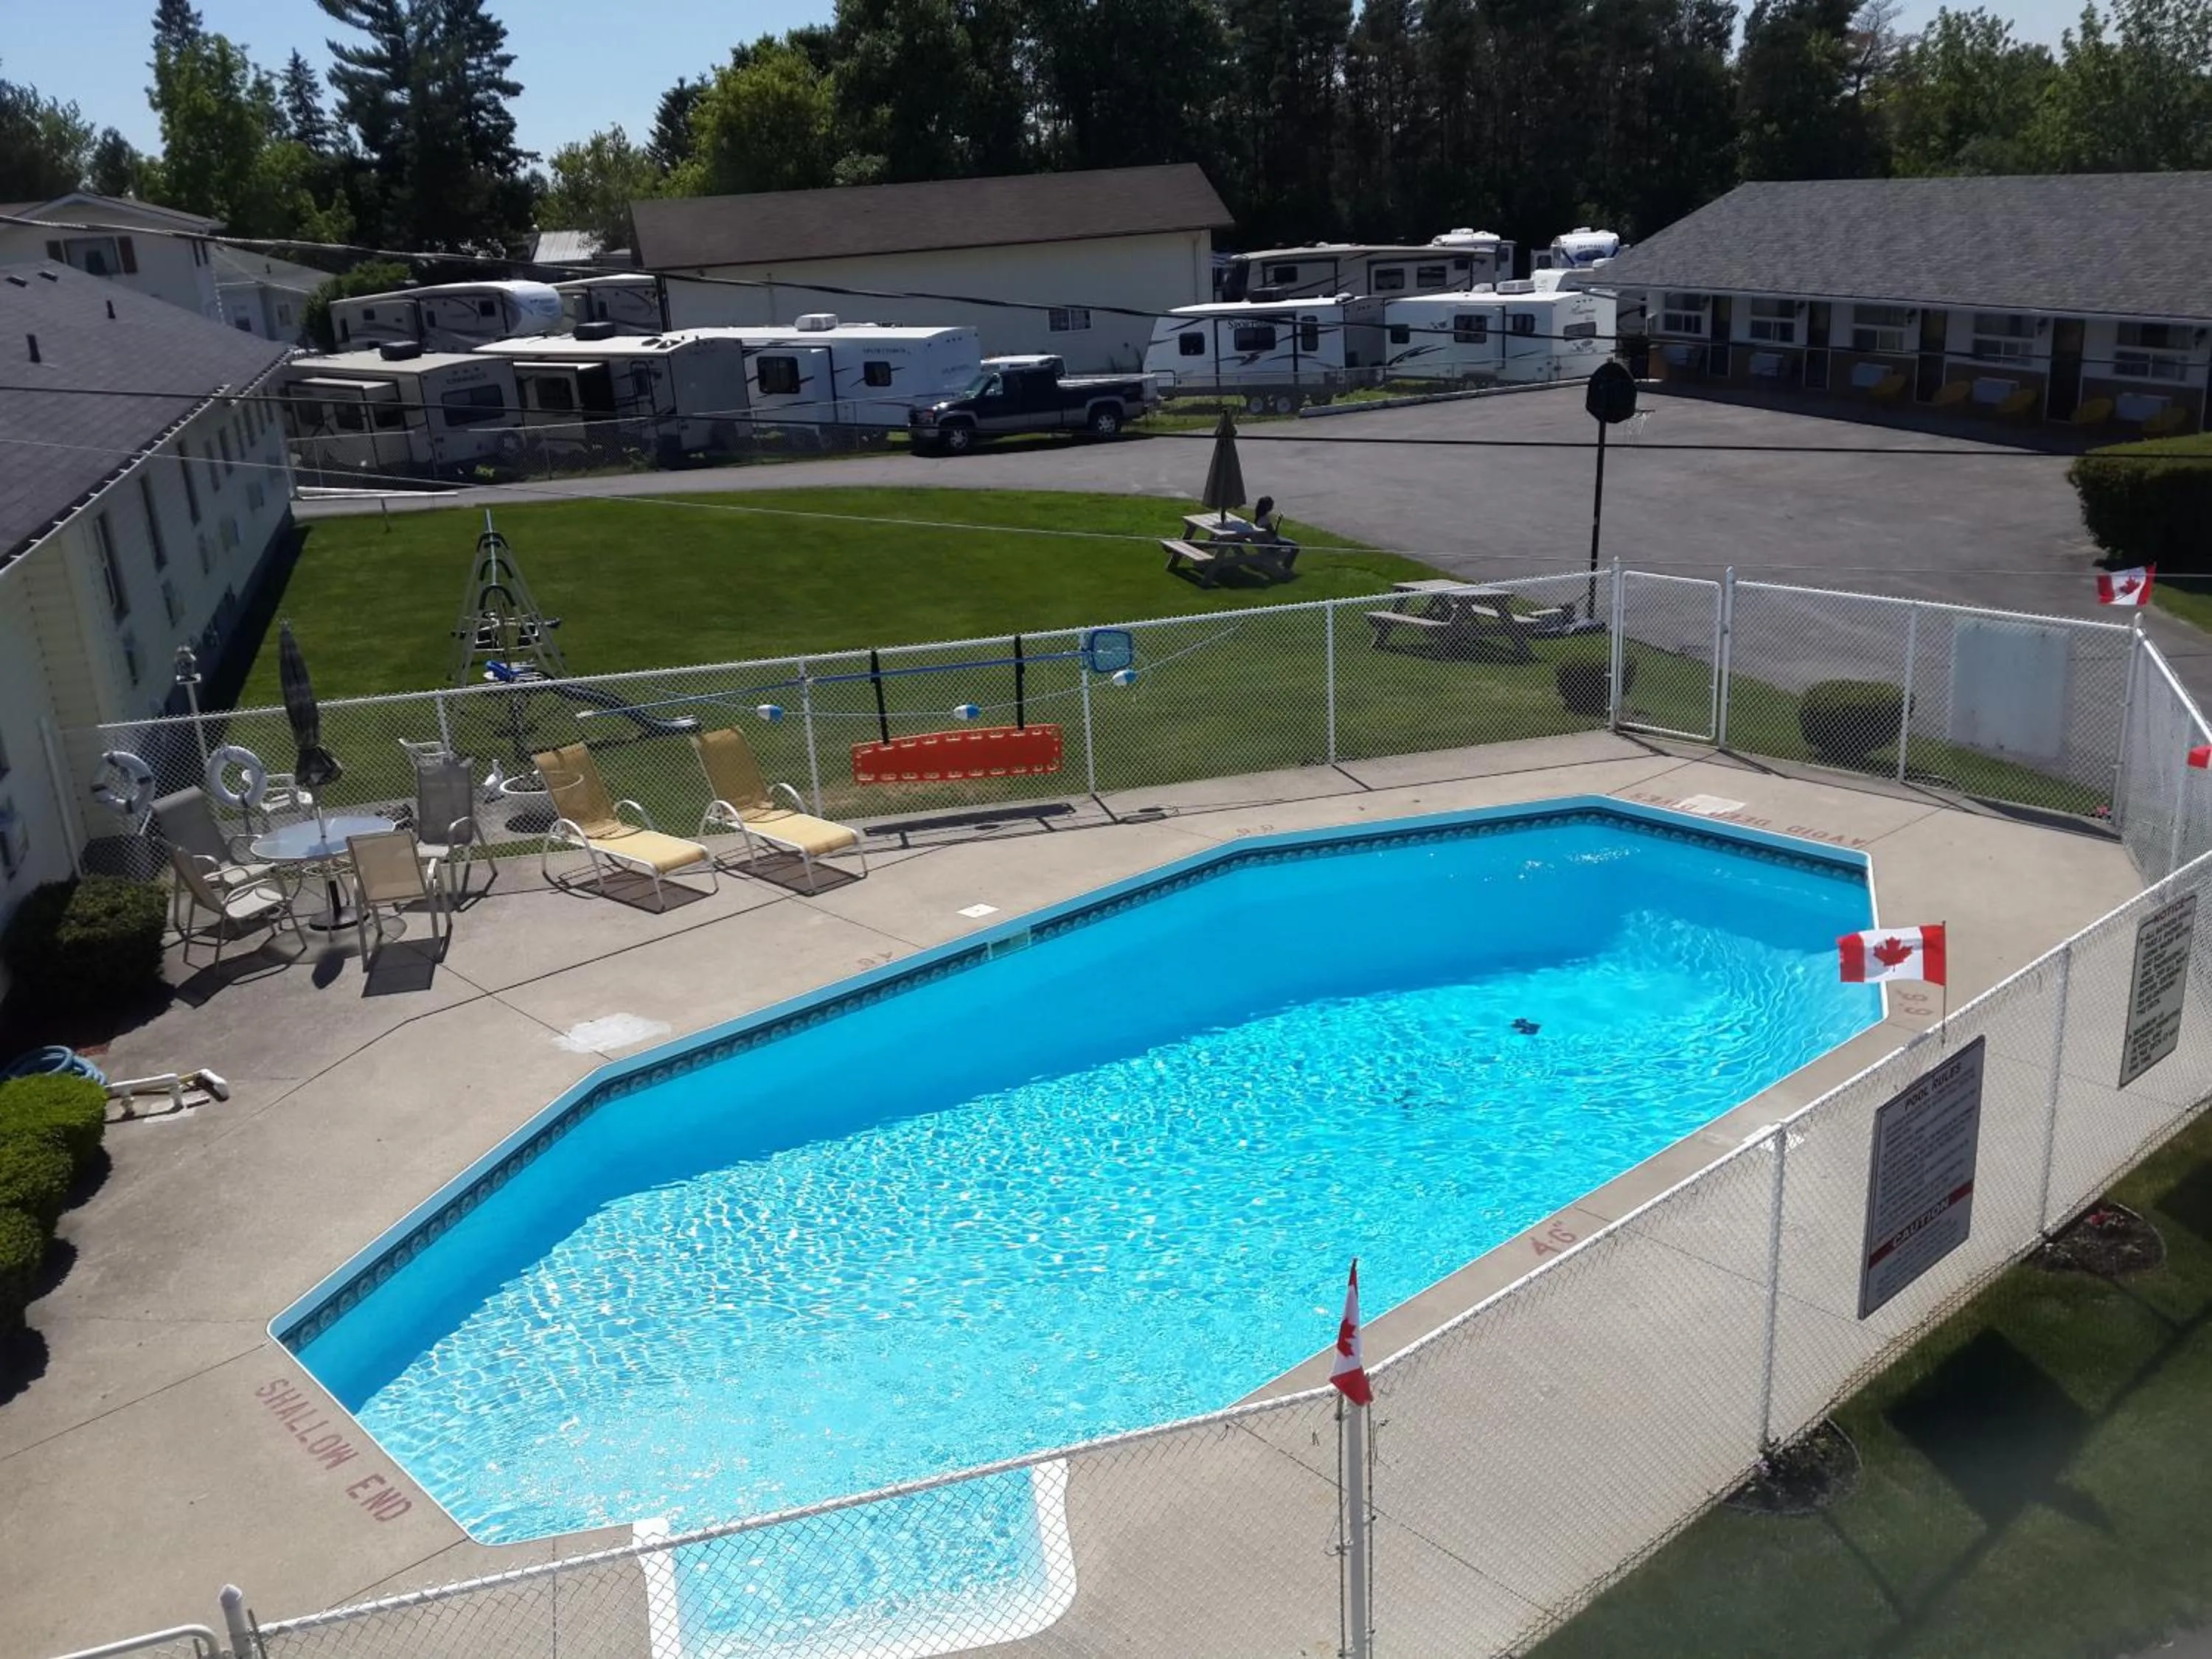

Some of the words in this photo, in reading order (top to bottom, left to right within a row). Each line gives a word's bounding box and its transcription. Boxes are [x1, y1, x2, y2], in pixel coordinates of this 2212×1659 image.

[1892, 1197, 1951, 1249] CAUTION
[255, 1378, 360, 1471] SHALLOW
[345, 1473, 412, 1523] END
